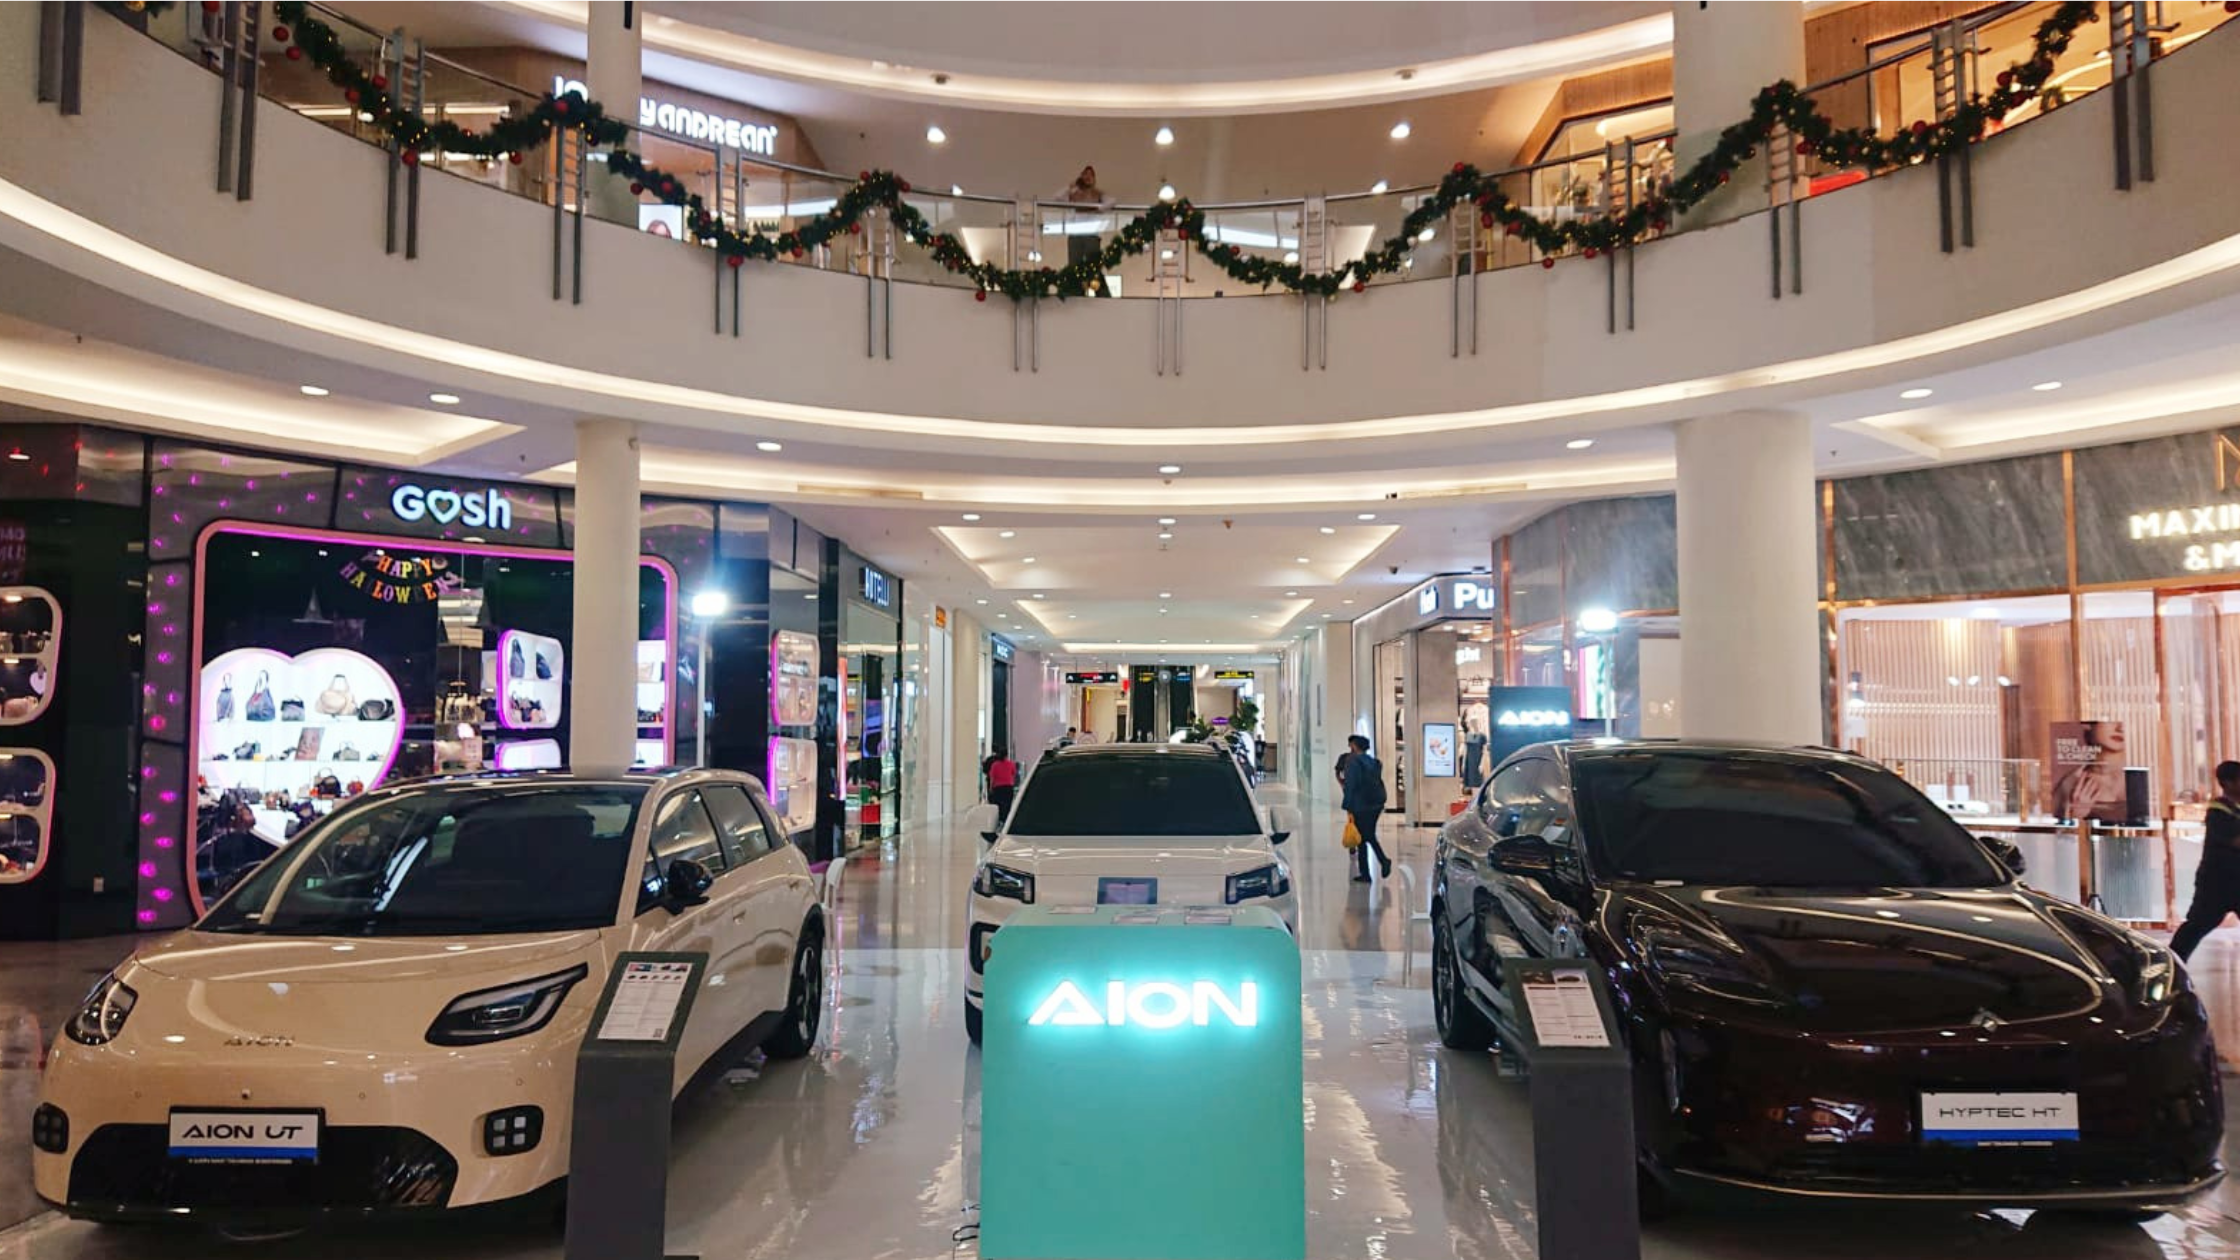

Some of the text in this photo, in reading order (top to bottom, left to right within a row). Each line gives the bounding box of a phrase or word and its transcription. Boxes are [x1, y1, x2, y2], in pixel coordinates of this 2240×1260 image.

[339, 561, 452, 604] HALOWEN
[1498, 710, 1570, 726] AION
[1027, 979, 1258, 1030] AION
[223, 1035, 295, 1047] AION
[1939, 1107, 2061, 1118] HYPTEC HT
[182, 1124, 303, 1139] AION UT
